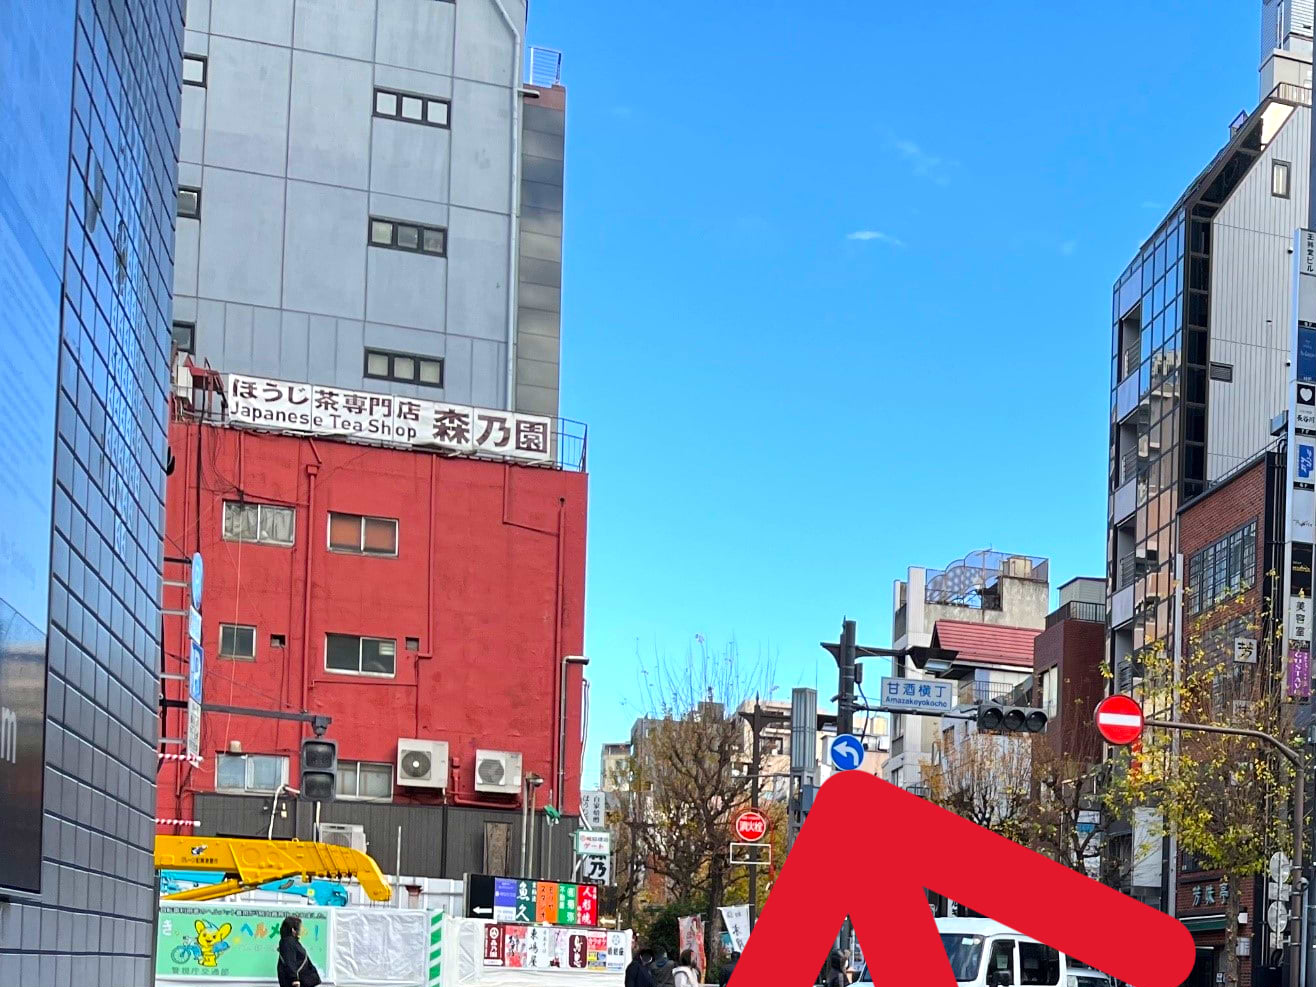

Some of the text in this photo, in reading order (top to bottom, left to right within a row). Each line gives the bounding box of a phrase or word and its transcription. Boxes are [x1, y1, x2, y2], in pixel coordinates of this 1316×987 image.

[230, 401, 417, 440] Japanese Tea Shop
[232, 378, 548, 454] ほうじ茶専門店 森乃園
[885, 696, 948, 707] Amazakeyokocho
[887, 682, 946, 698] 甘酒横丁
[739, 820, 764, 833] 消火栓
[516, 880, 530, 922] 魚久
